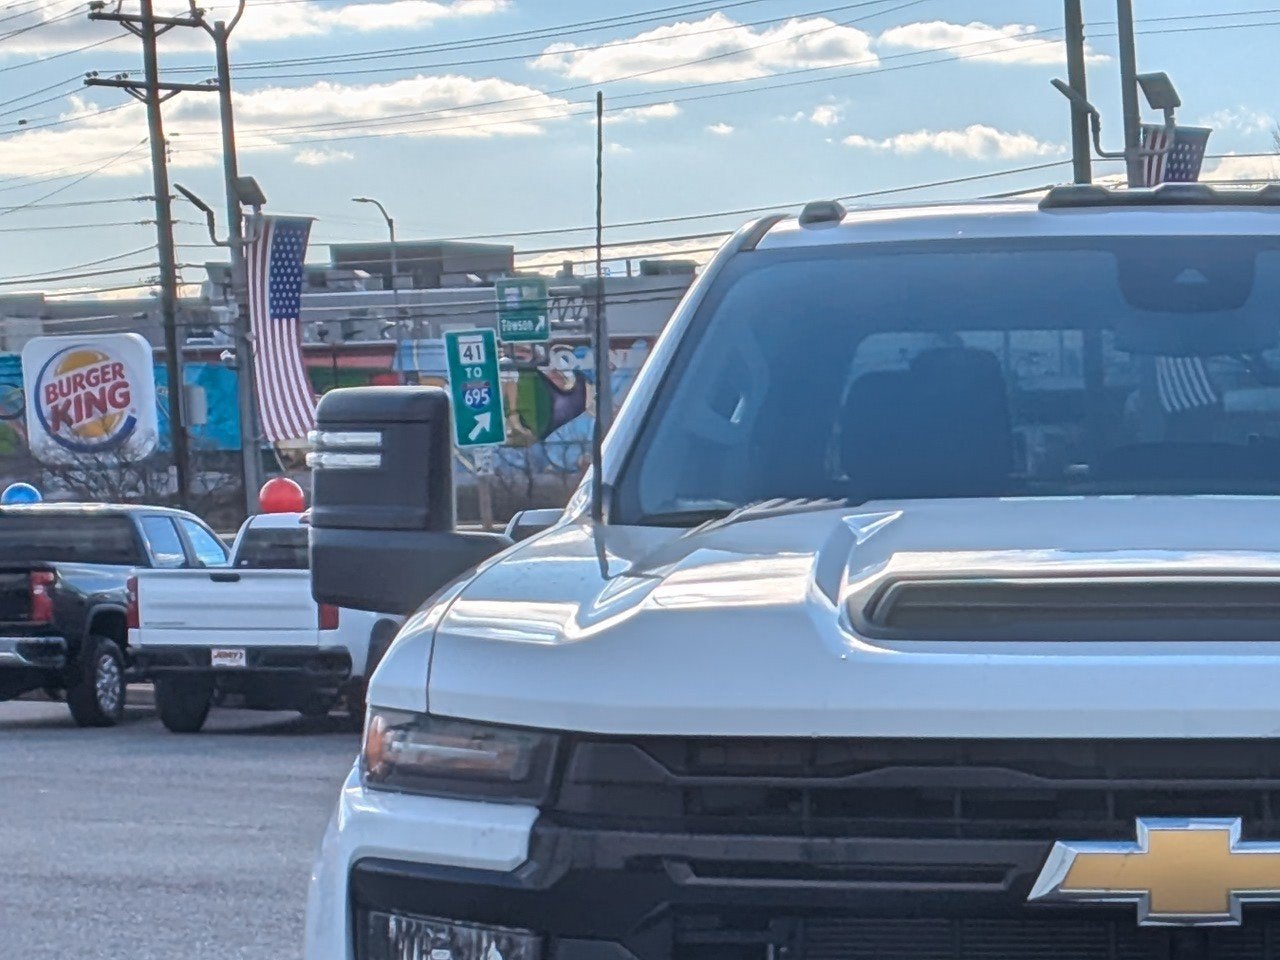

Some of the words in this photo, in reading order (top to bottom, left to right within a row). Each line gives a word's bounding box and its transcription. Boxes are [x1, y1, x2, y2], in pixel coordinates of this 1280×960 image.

[463, 345, 482, 361] 41
[465, 367, 482, 378] TO
[45, 362, 125, 405] BURGER
[464, 388, 490, 404] 695
[51, 381, 131, 431] KING
